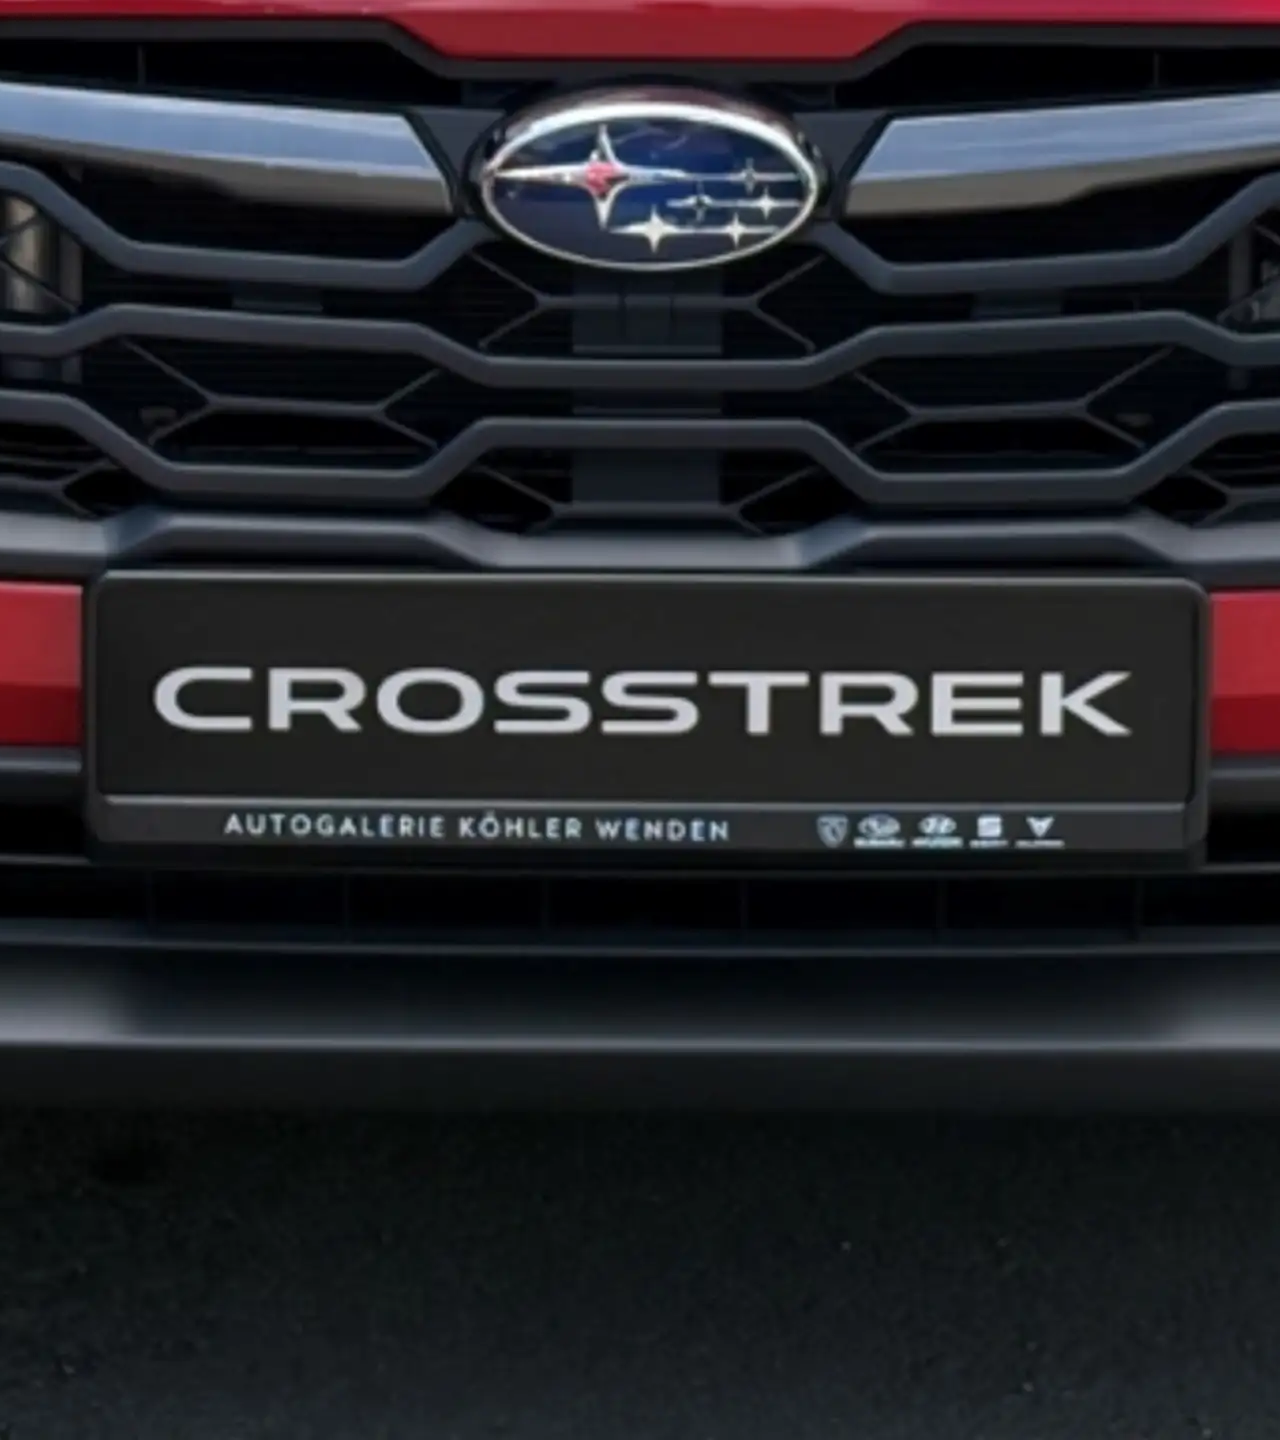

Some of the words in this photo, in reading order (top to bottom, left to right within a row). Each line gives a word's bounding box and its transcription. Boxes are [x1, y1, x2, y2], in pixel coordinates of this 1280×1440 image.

[153, 666, 1131, 737] CROSSTREK
[224, 812, 446, 839] AUTOGALERIE
[458, 809, 583, 841] KÖHLER
[595, 816, 731, 843] WENDEN
